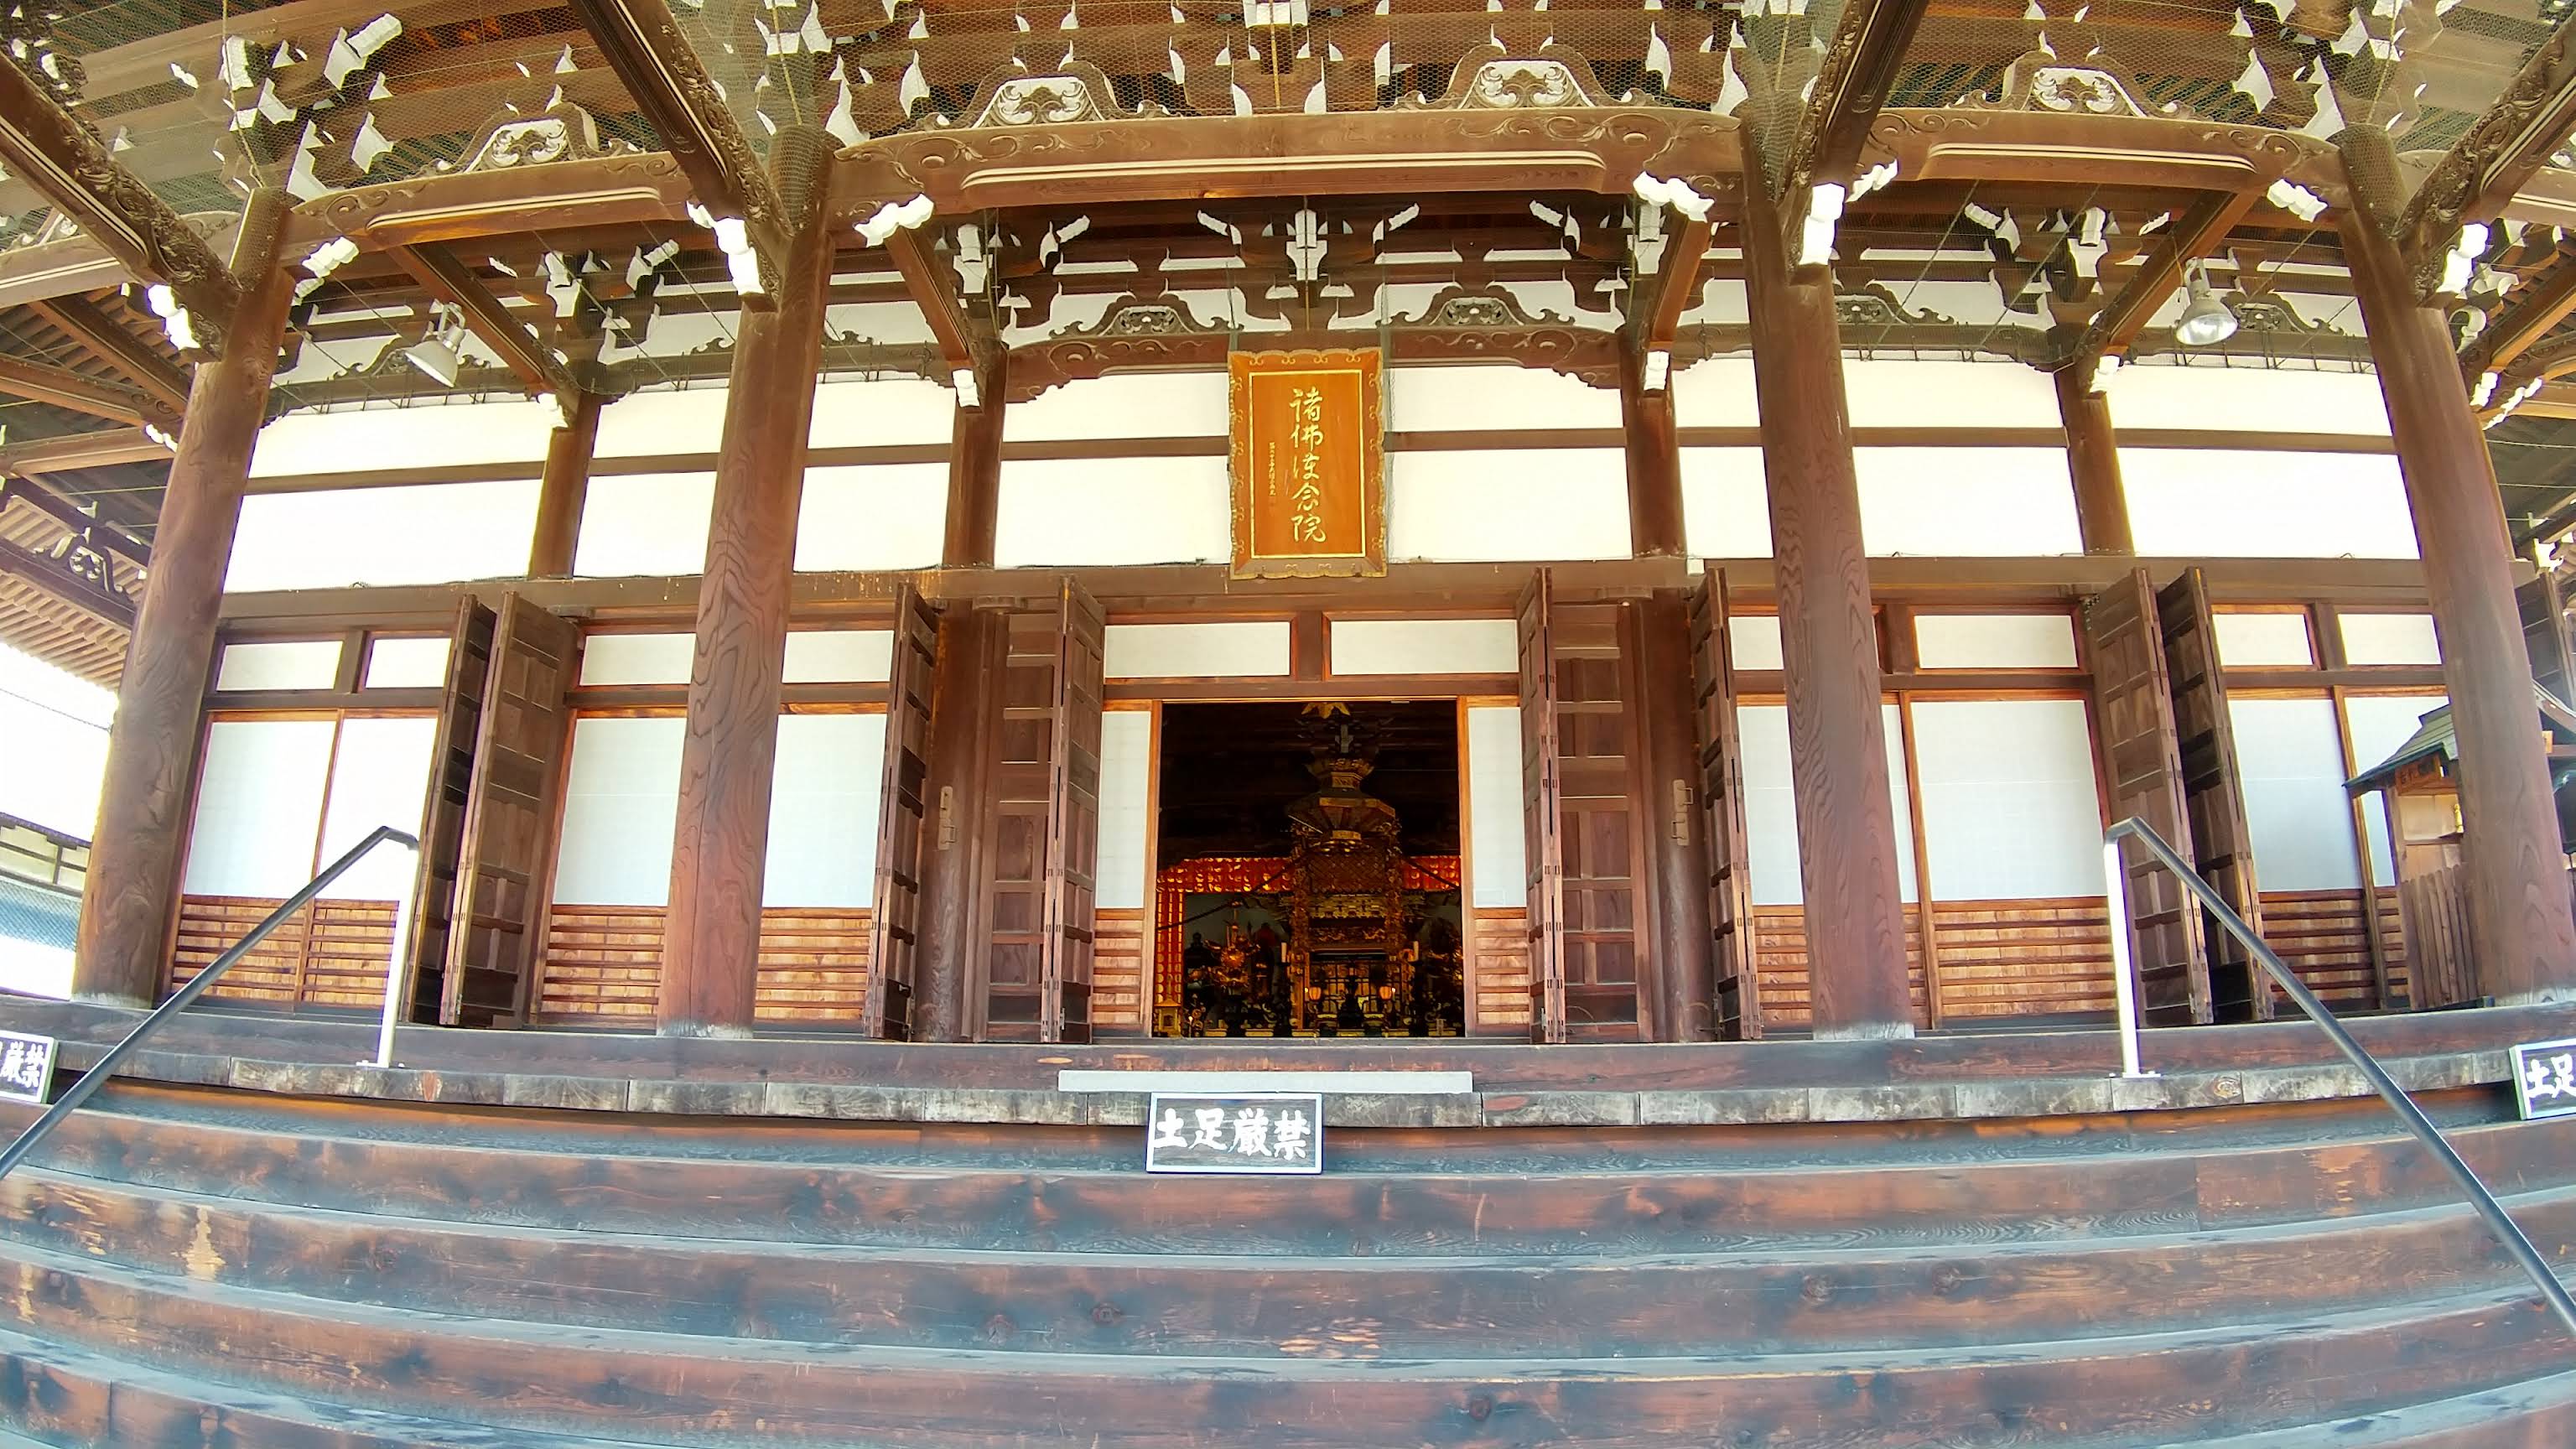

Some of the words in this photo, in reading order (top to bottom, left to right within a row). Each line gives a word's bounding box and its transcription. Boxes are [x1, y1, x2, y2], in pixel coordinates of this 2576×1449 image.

[0, 1041, 45, 1088] 厳禁
[1153, 1107, 1311, 1161] 土足厳禁
